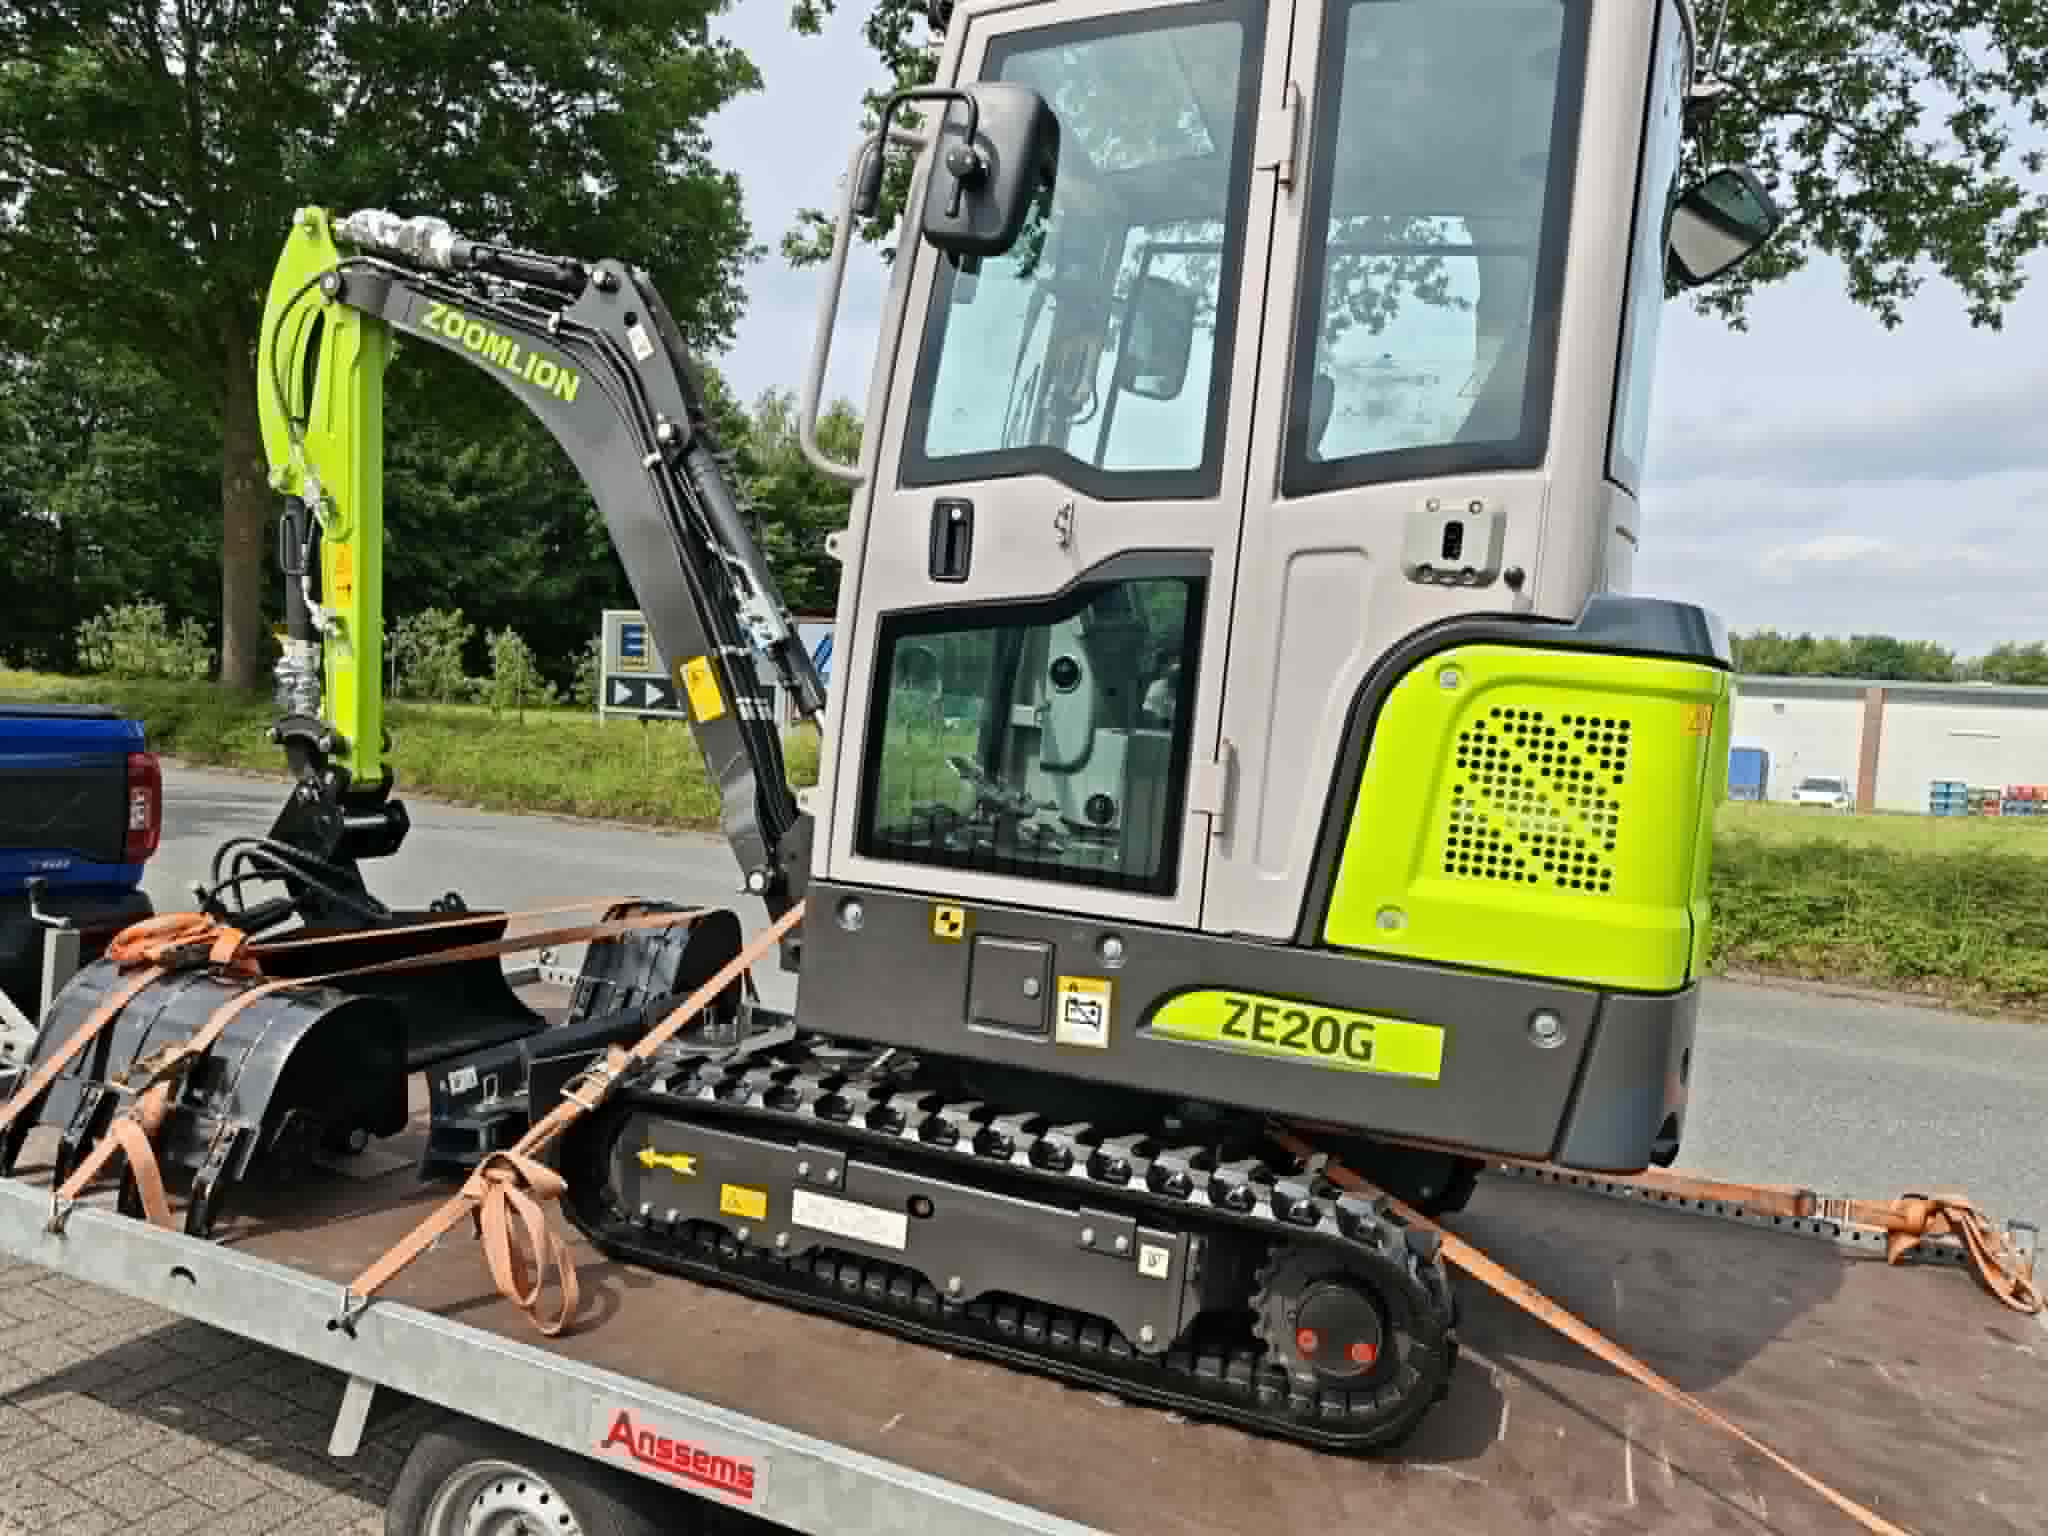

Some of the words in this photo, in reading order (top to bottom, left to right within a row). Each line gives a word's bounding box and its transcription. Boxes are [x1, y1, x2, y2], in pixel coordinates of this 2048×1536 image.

[421, 299, 581, 403] ZOOMLION
[1220, 996, 1376, 1061] ZE20G
[601, 1409, 755, 1490] Anssems
